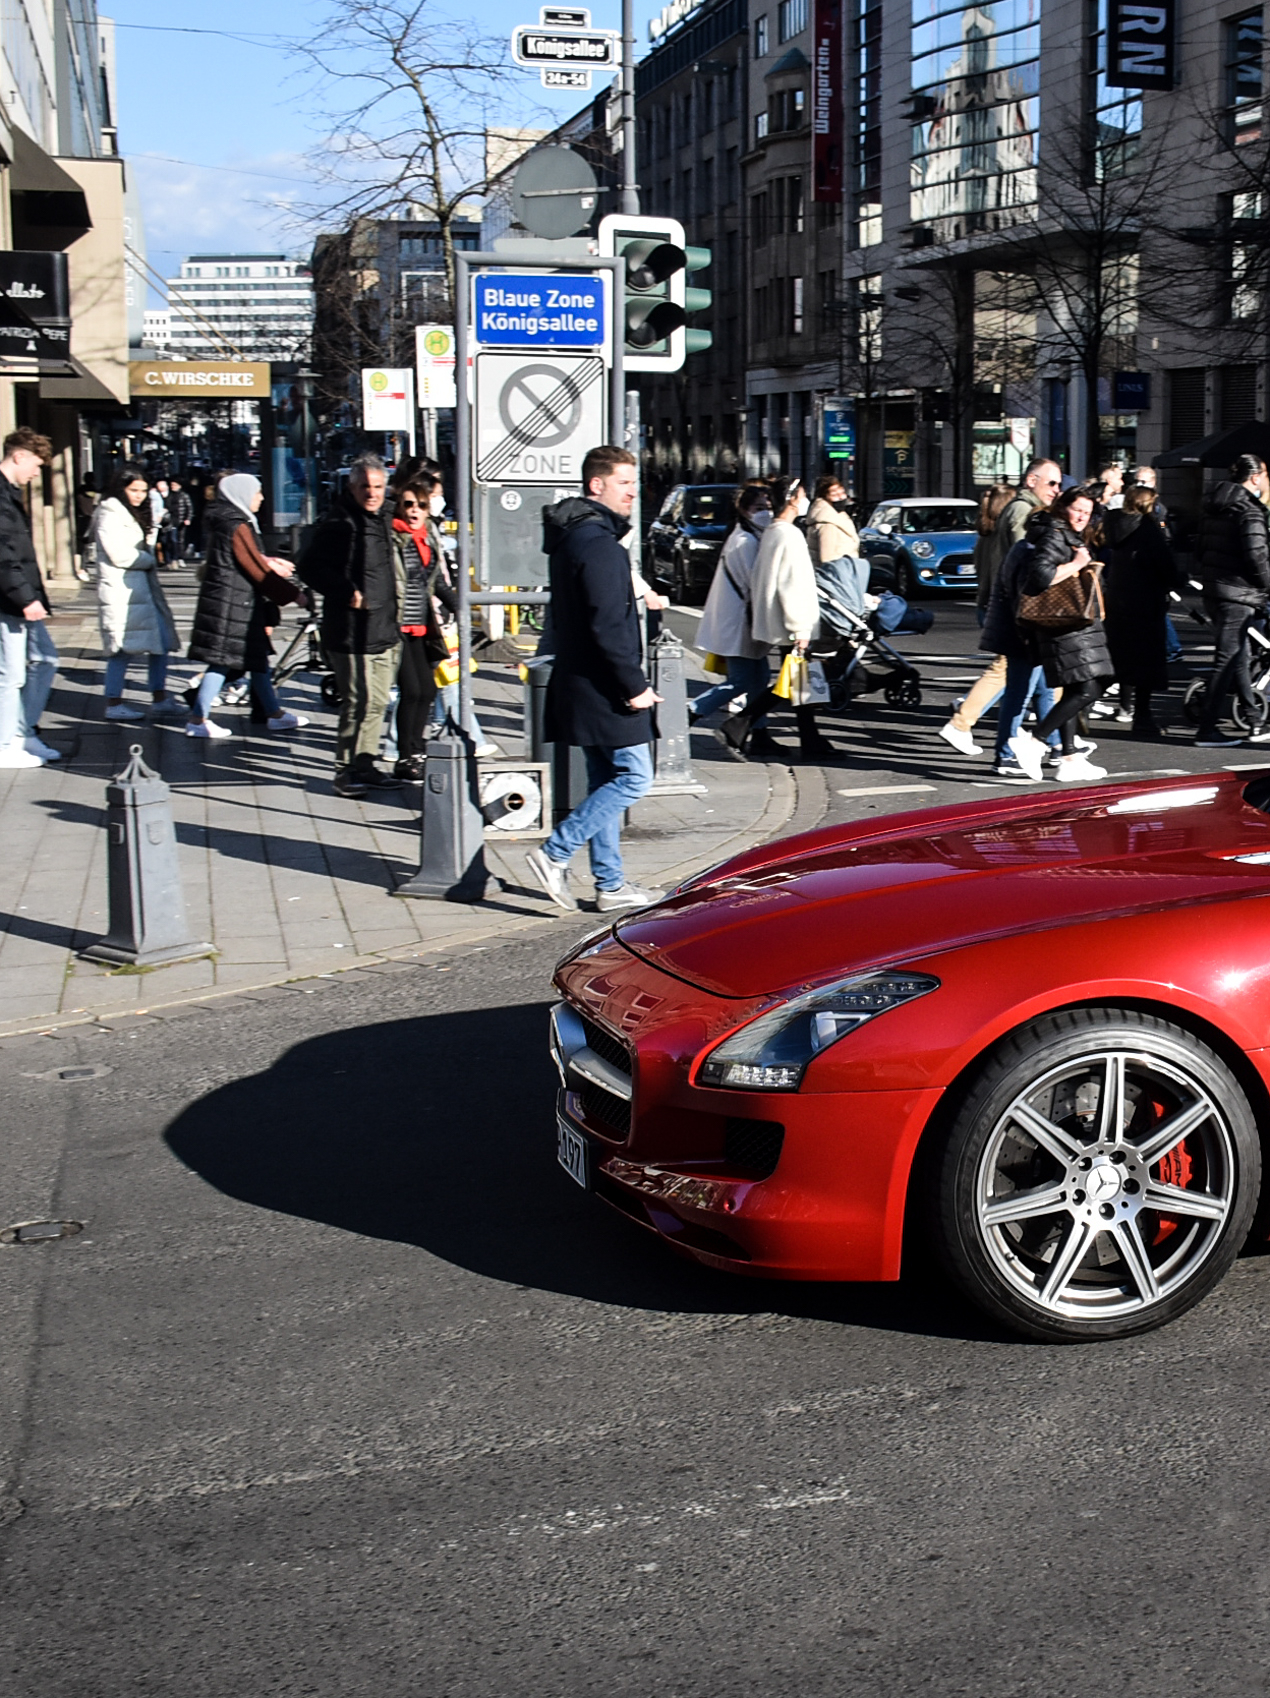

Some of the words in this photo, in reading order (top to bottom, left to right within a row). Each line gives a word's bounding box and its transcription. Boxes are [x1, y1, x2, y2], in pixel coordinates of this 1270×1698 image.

[527, 37, 605, 58] Königsallee
[815, 47, 832, 134] Weingarten
[484, 288, 541, 307] Blaue
[546, 290, 595, 308] Zone
[482, 312, 598, 335] Königsallee
[144, 371, 254, 386] C.WIRSCHKE
[509, 454, 572, 474] ZONE
